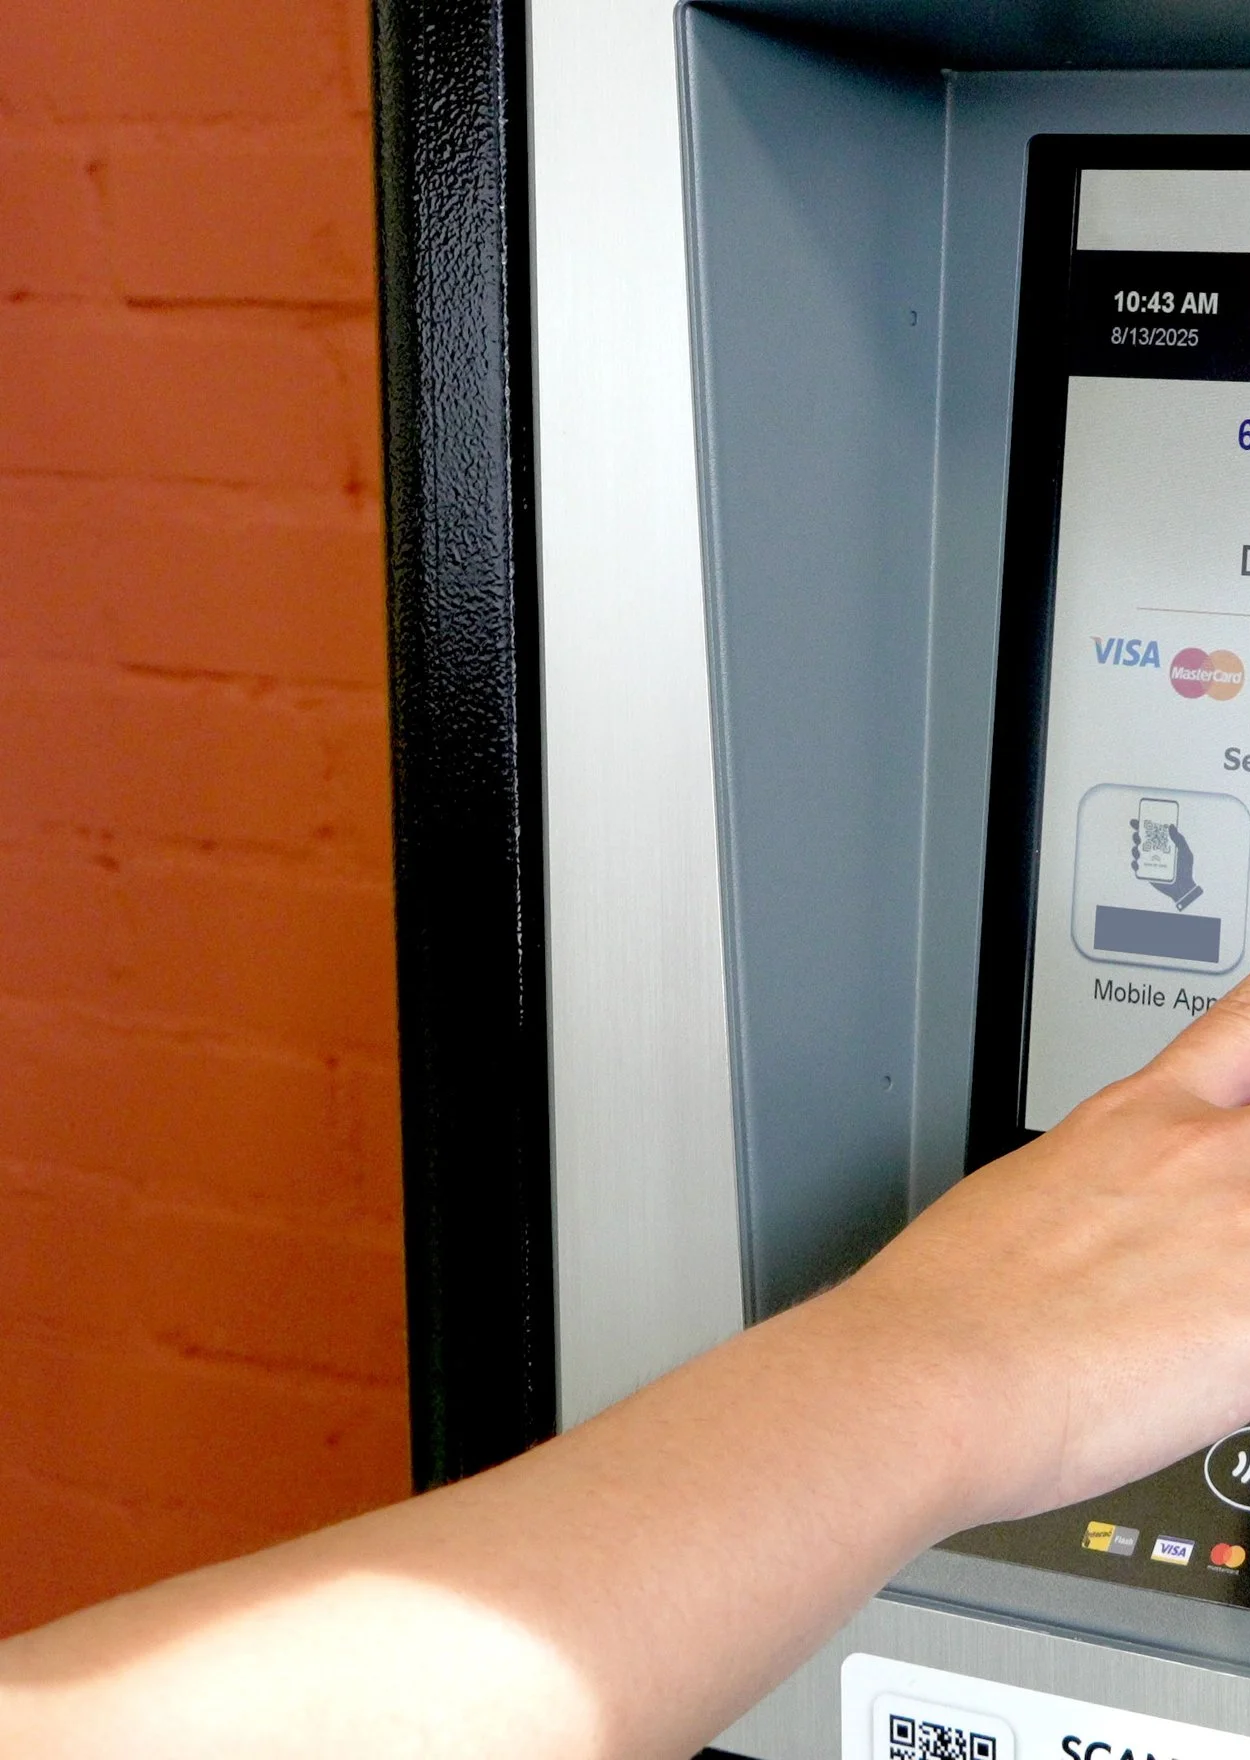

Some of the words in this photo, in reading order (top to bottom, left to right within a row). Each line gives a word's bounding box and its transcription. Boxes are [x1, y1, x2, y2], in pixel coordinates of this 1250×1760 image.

[1114, 290, 1175, 313] 10:43
[1180, 292, 1219, 315] AM
[1111, 326, 1199, 347] 8/13/2025
[1090, 636, 1162, 668] VISA
[1171, 665, 1243, 685] MasterCard
[1094, 978, 1165, 1007] Mobile
[1160, 1543, 1187, 1557] VISA
